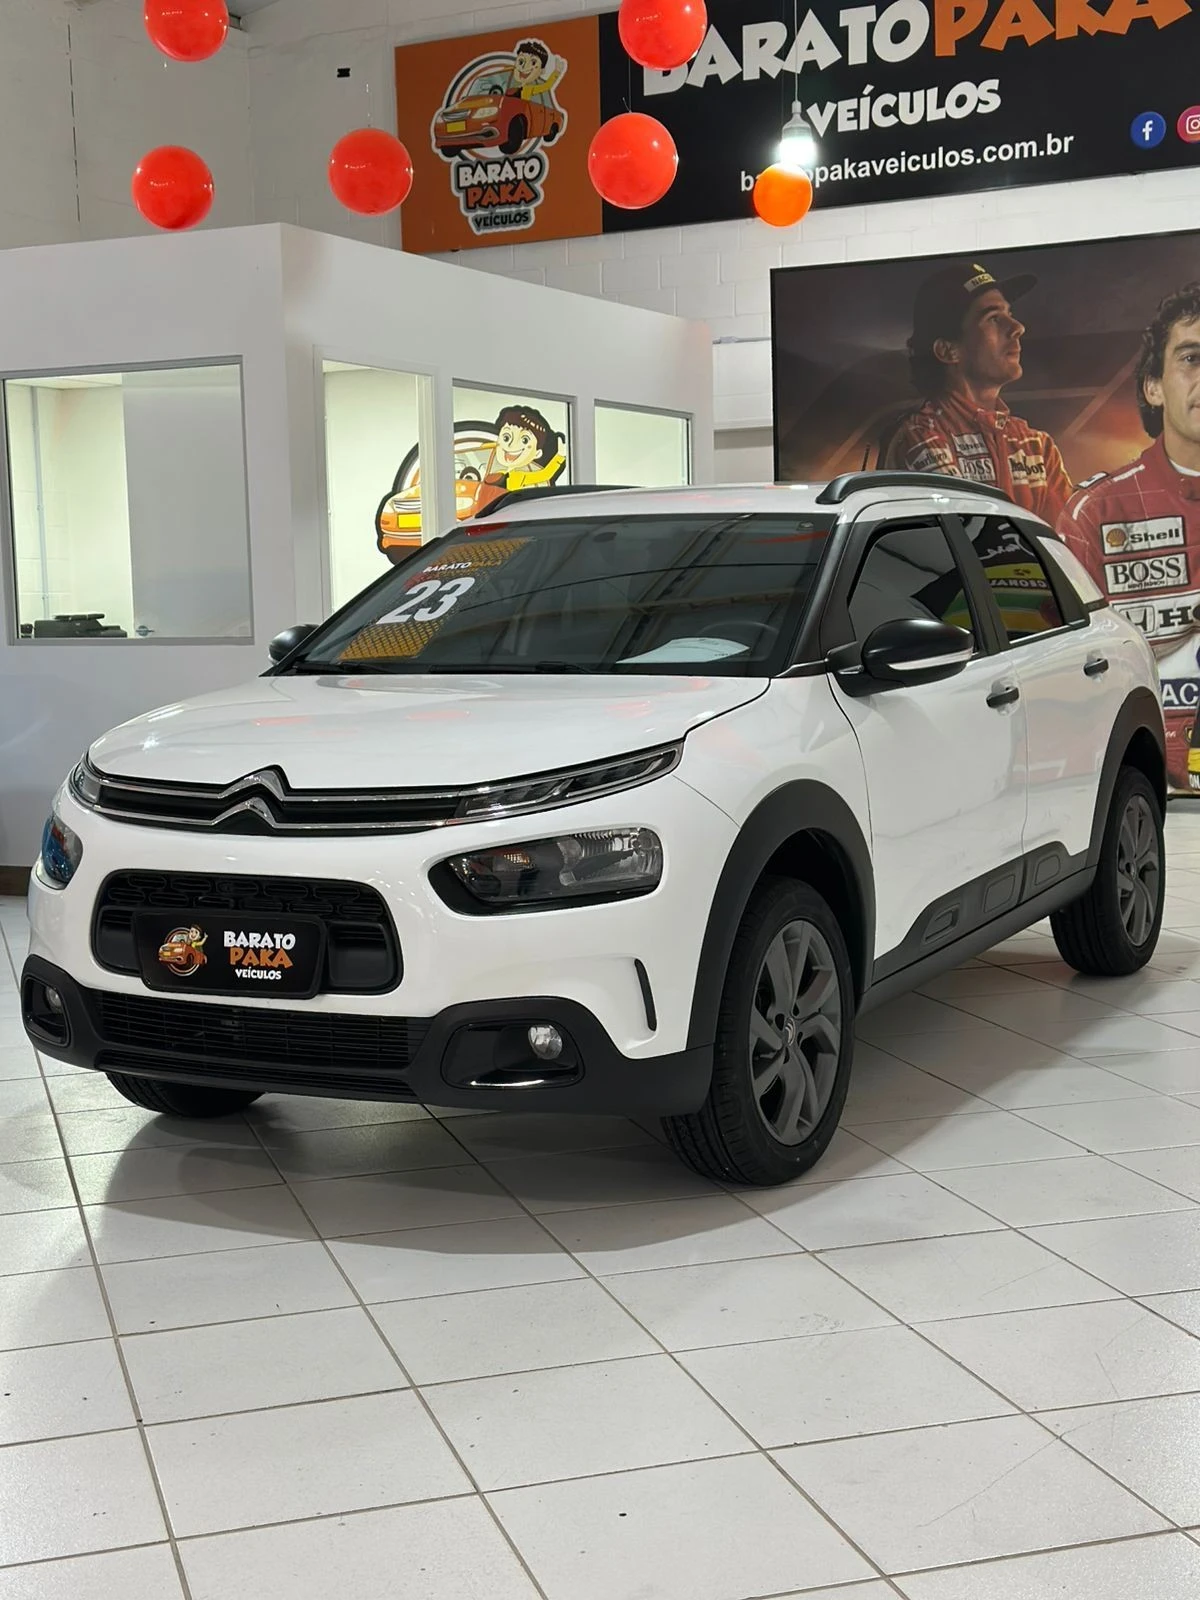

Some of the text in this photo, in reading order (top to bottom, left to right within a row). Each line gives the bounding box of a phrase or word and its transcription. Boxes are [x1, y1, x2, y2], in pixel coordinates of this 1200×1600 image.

[807, 79, 1001, 137] VEÍCULOS
[458, 157, 542, 187] BARATO
[741, 132, 1075, 192] bpakaveiculos.com.br
[465, 181, 535, 209] PAKA
[474, 211, 530, 228] VEÍCULOS
[1130, 528, 1180, 544] Shell
[423, 562, 472, 573] BARATO
[1110, 557, 1181, 585] BOSS
[376, 577, 475, 624] 23
[1158, 606, 1194, 628] H
[223, 931, 296, 950] BARATO
[229, 947, 293, 969] PAKA
[235, 967, 282, 980] VEÍCULOS
